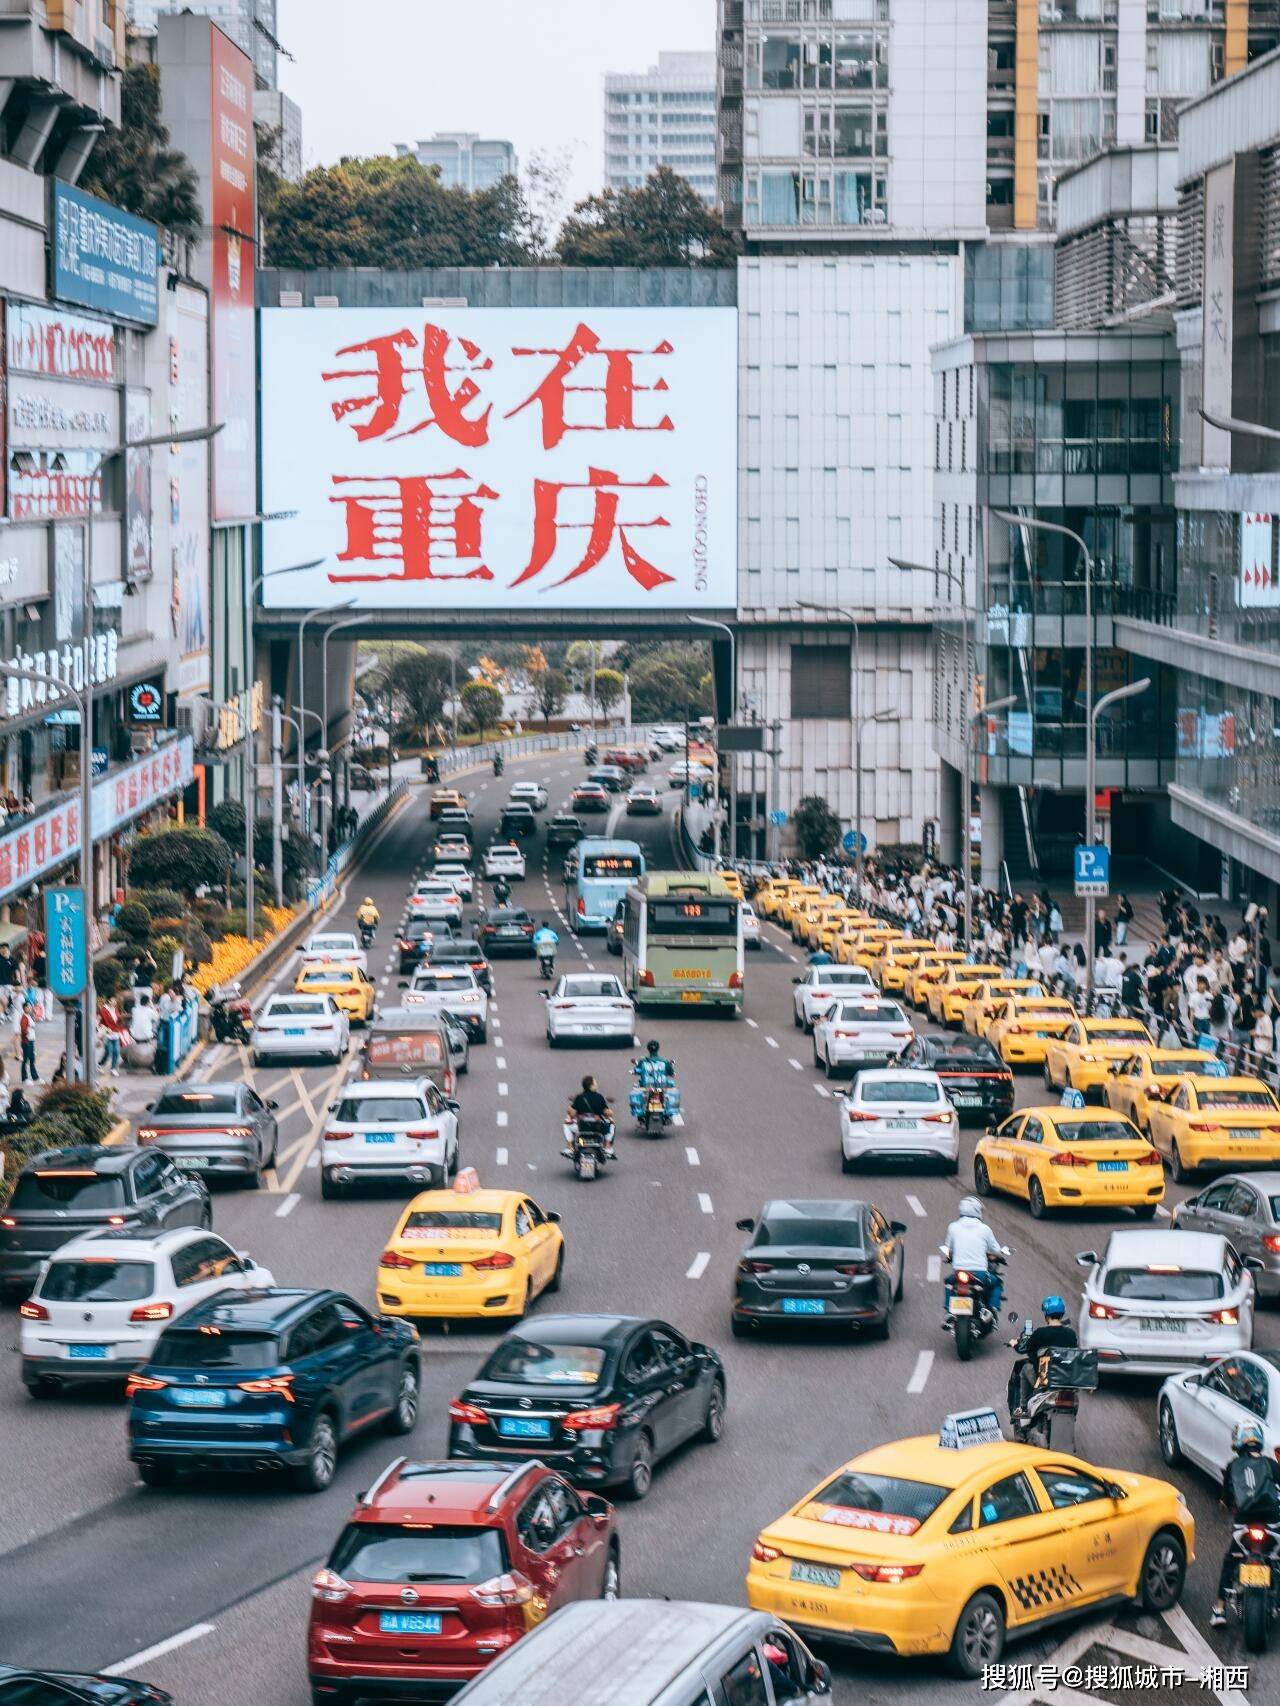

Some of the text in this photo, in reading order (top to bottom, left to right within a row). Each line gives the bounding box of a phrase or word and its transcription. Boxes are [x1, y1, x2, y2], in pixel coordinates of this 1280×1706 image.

[321, 323, 675, 450] 我在
[328, 466, 676, 591] 重庆
[693, 474, 708, 591] CHONGQING
[54, 893, 70, 913] P
[1078, 851, 1096, 877] P
